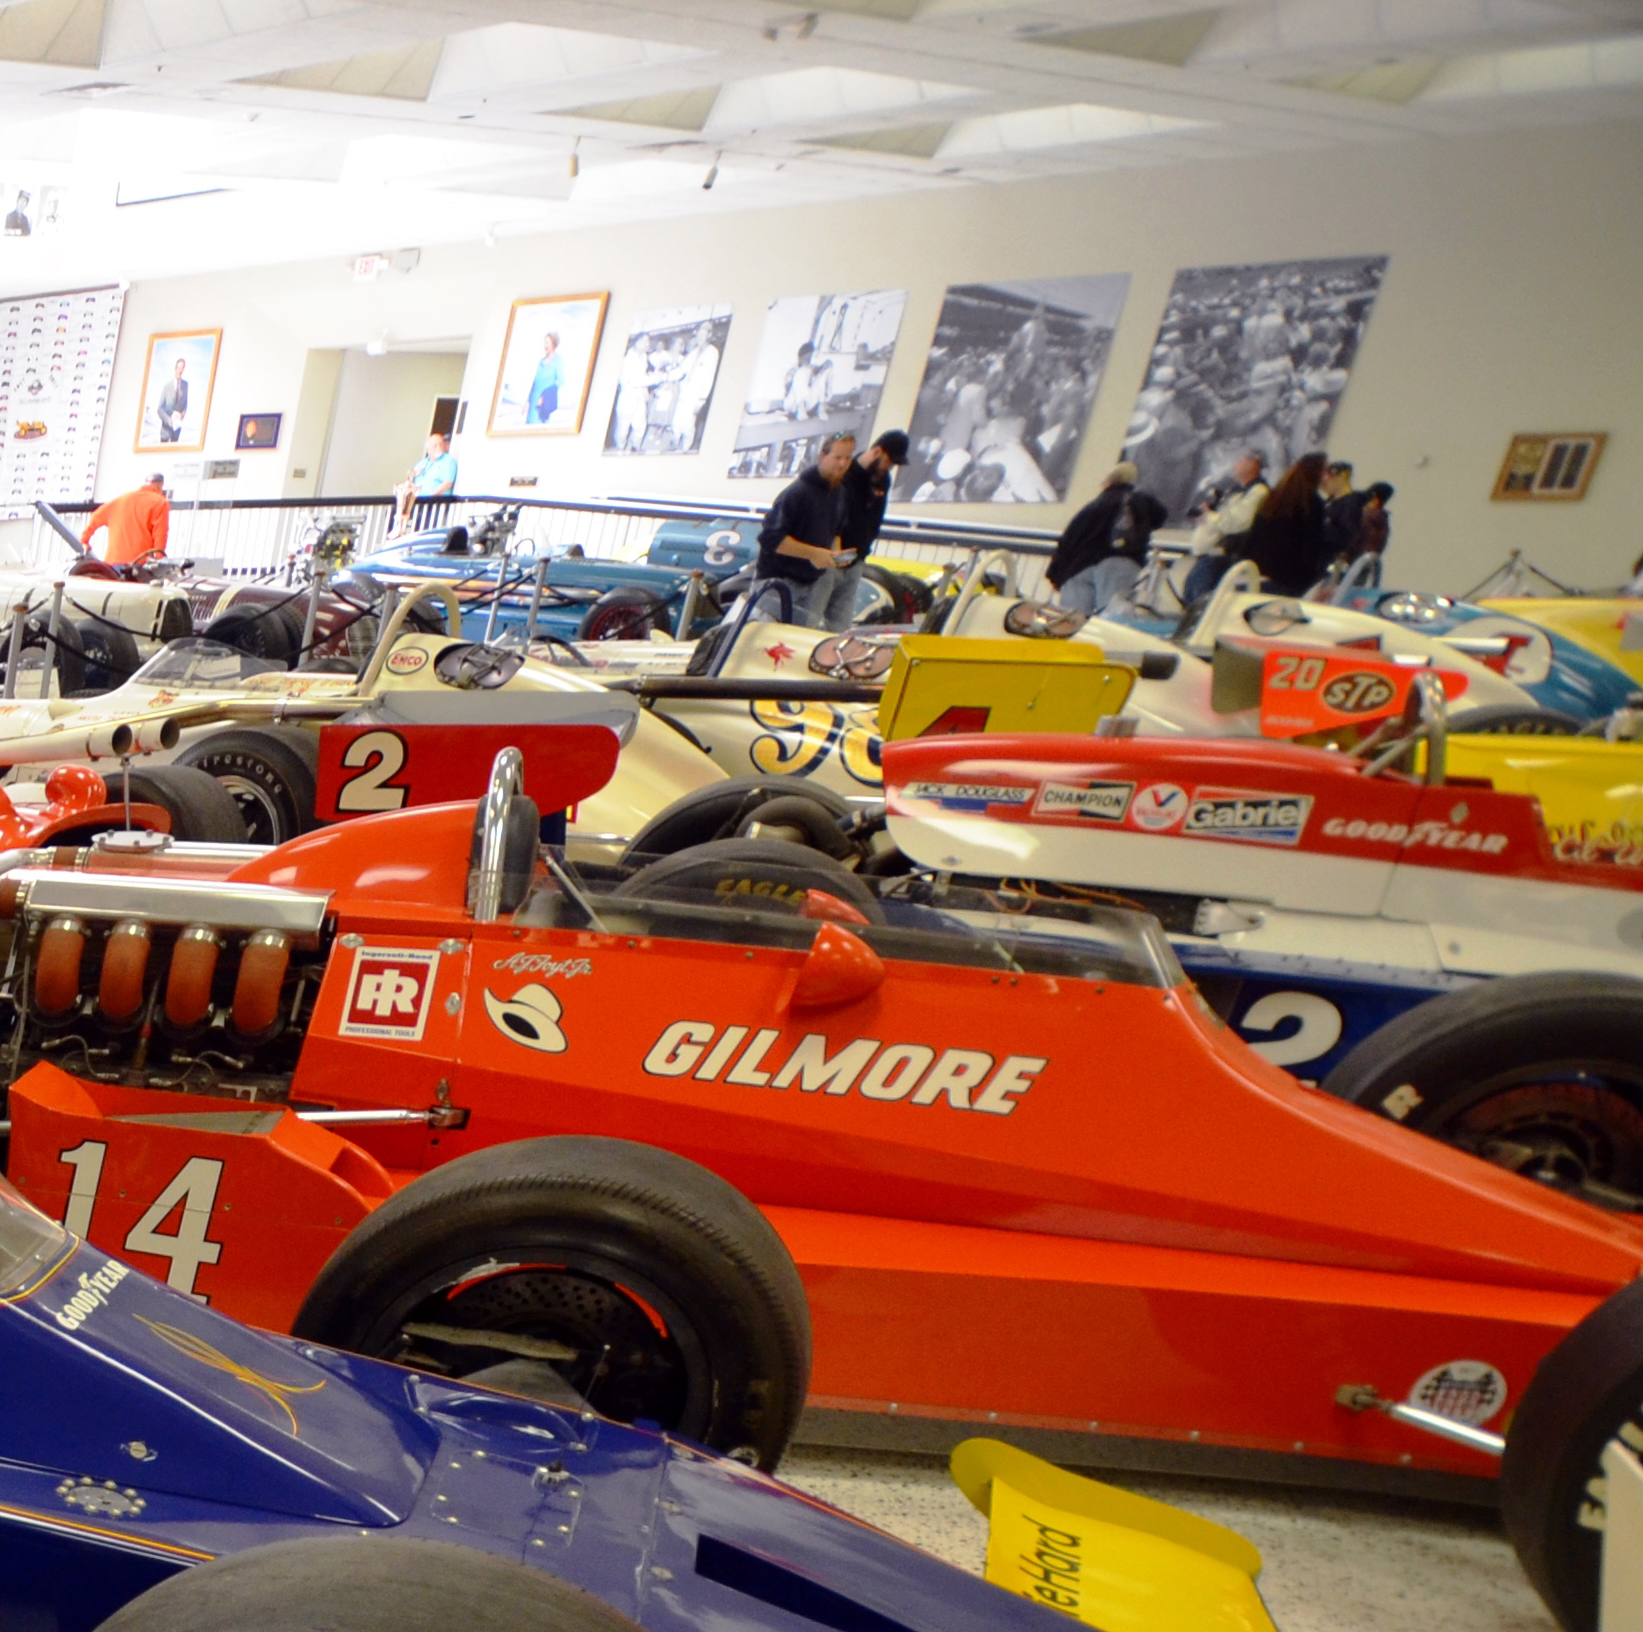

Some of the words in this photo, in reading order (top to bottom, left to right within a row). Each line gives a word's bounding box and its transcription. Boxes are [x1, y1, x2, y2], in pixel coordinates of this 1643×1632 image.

[1267, 656, 1328, 691] 20
[1324, 675, 1392, 710] STP
[338, 730, 410, 812] 2
[1043, 788, 1124, 809] CHAMPION
[1190, 798, 1303, 829] Gabriel
[1322, 817, 1509, 855] GOODYEAR
[642, 1019, 1049, 1117] GILMORE
[59, 1138, 225, 1306] 14
[56, 1259, 131, 1331] GOODYEAR
[1018, 1513, 1082, 1618] ieHard
